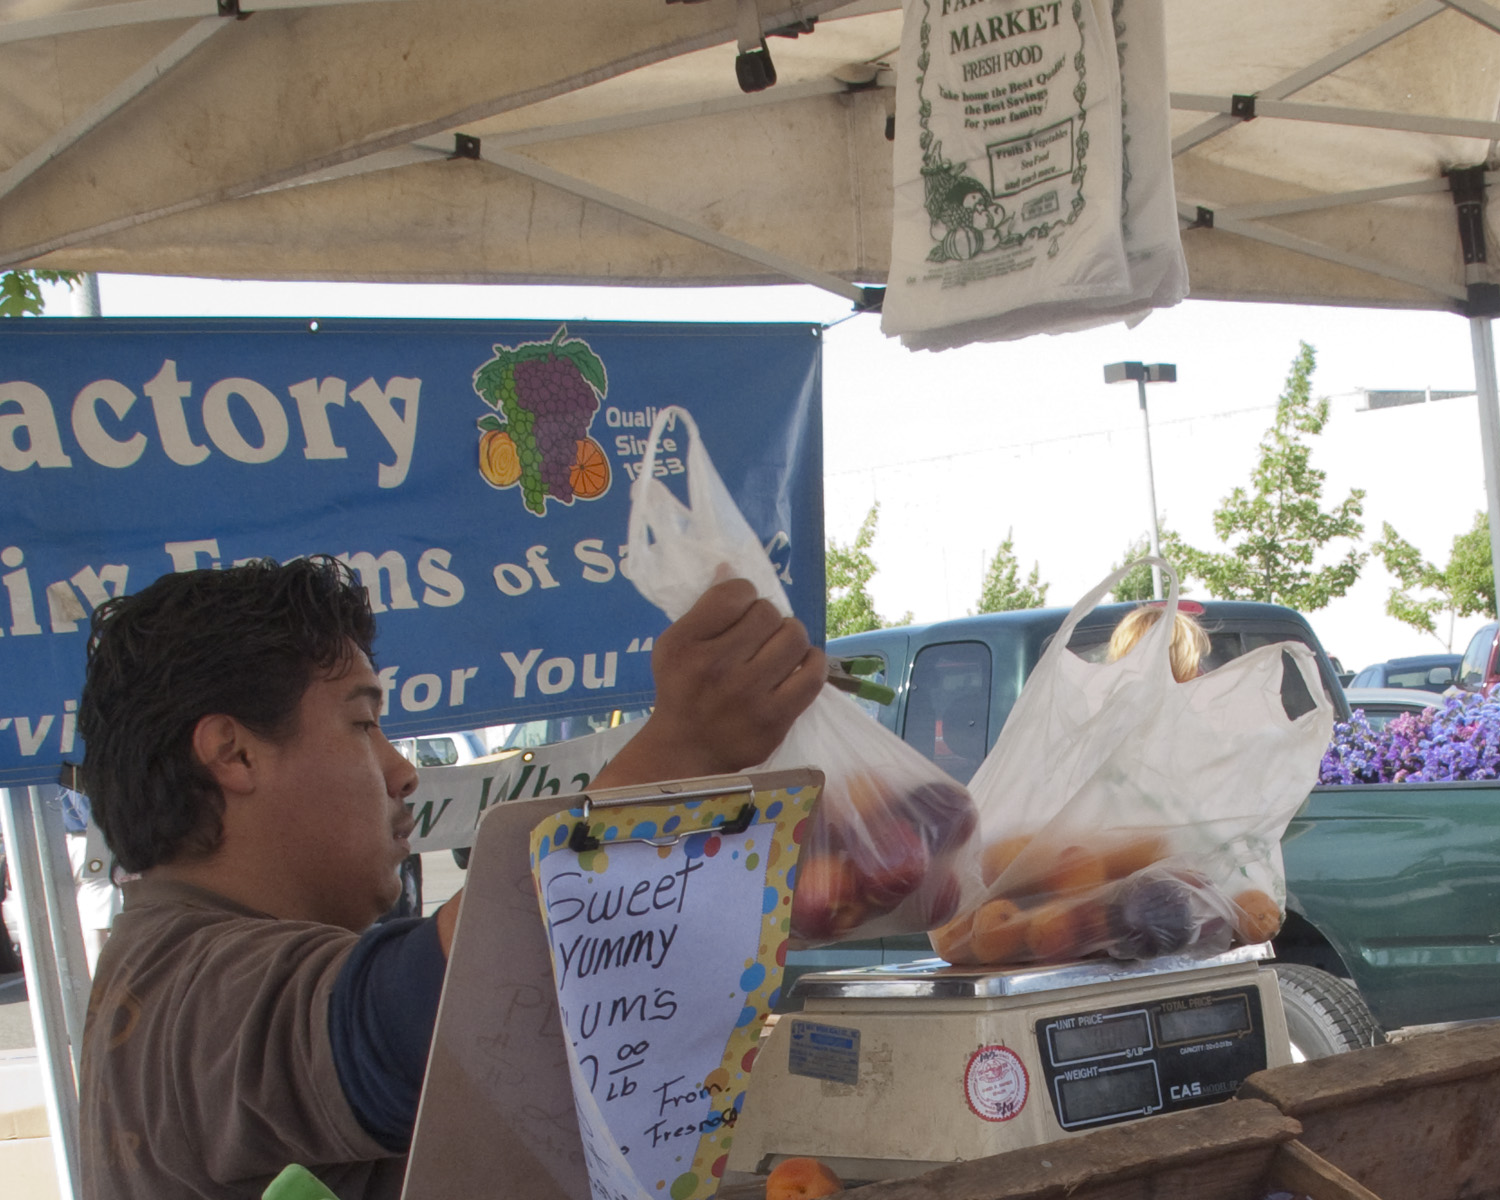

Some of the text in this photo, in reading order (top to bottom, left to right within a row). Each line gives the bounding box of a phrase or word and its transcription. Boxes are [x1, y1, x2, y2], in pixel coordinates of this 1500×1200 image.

[949, 2, 1063, 55] MARKET
[962, 44, 1043, 82] FRESH FOOD
[962, 91, 989, 101] home
[991, 86, 1007, 98] the
[1008, 77, 1033, 94] Best
[964, 88, 1048, 115] the Best Savings
[982, 115, 1006, 130] your
[0, 359, 422, 489] actory
[605, 406, 676, 433] Qualiy
[494, 545, 559, 596] of
[376, 666, 479, 716] for
[547, 856, 704, 927] Sweet
[559, 924, 678, 991] YUMMY
[1160, 996, 1213, 1013] TOTAL PRICE
[1056, 1013, 1103, 1030] UNIT PRICE
[1064, 1066, 1098, 1081] WEIGHT
[1170, 1082, 1202, 1100] CAS
[1143, 1105, 1153, 1115] LB
